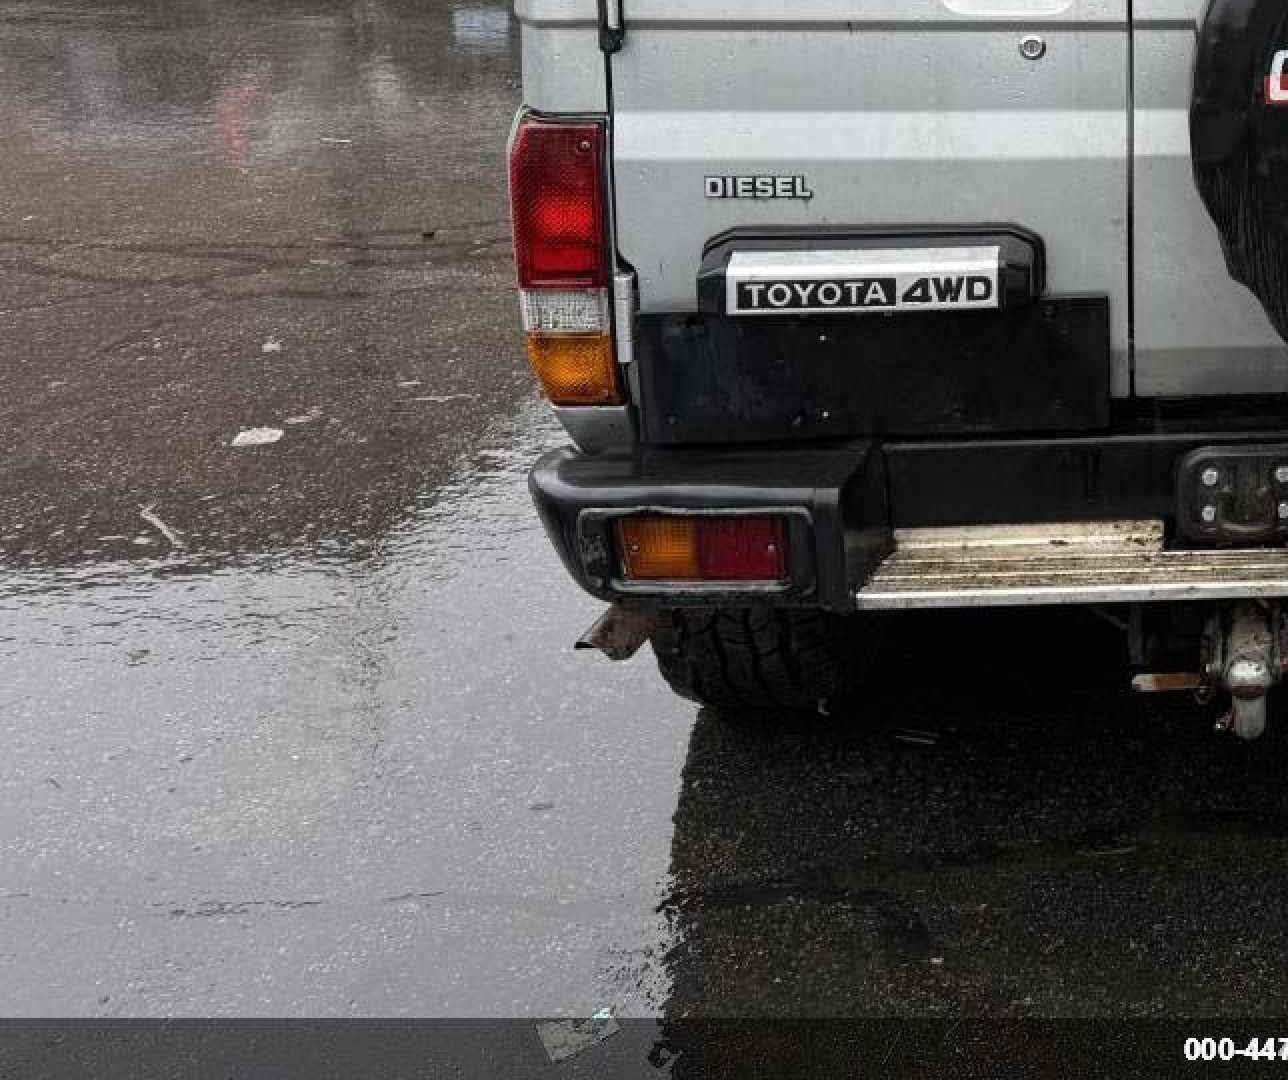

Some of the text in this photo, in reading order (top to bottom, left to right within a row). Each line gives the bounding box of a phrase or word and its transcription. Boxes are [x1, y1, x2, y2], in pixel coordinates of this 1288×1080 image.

[704, 176, 813, 199] DIESEL
[744, 277, 993, 307] TOYOTA 4WD
